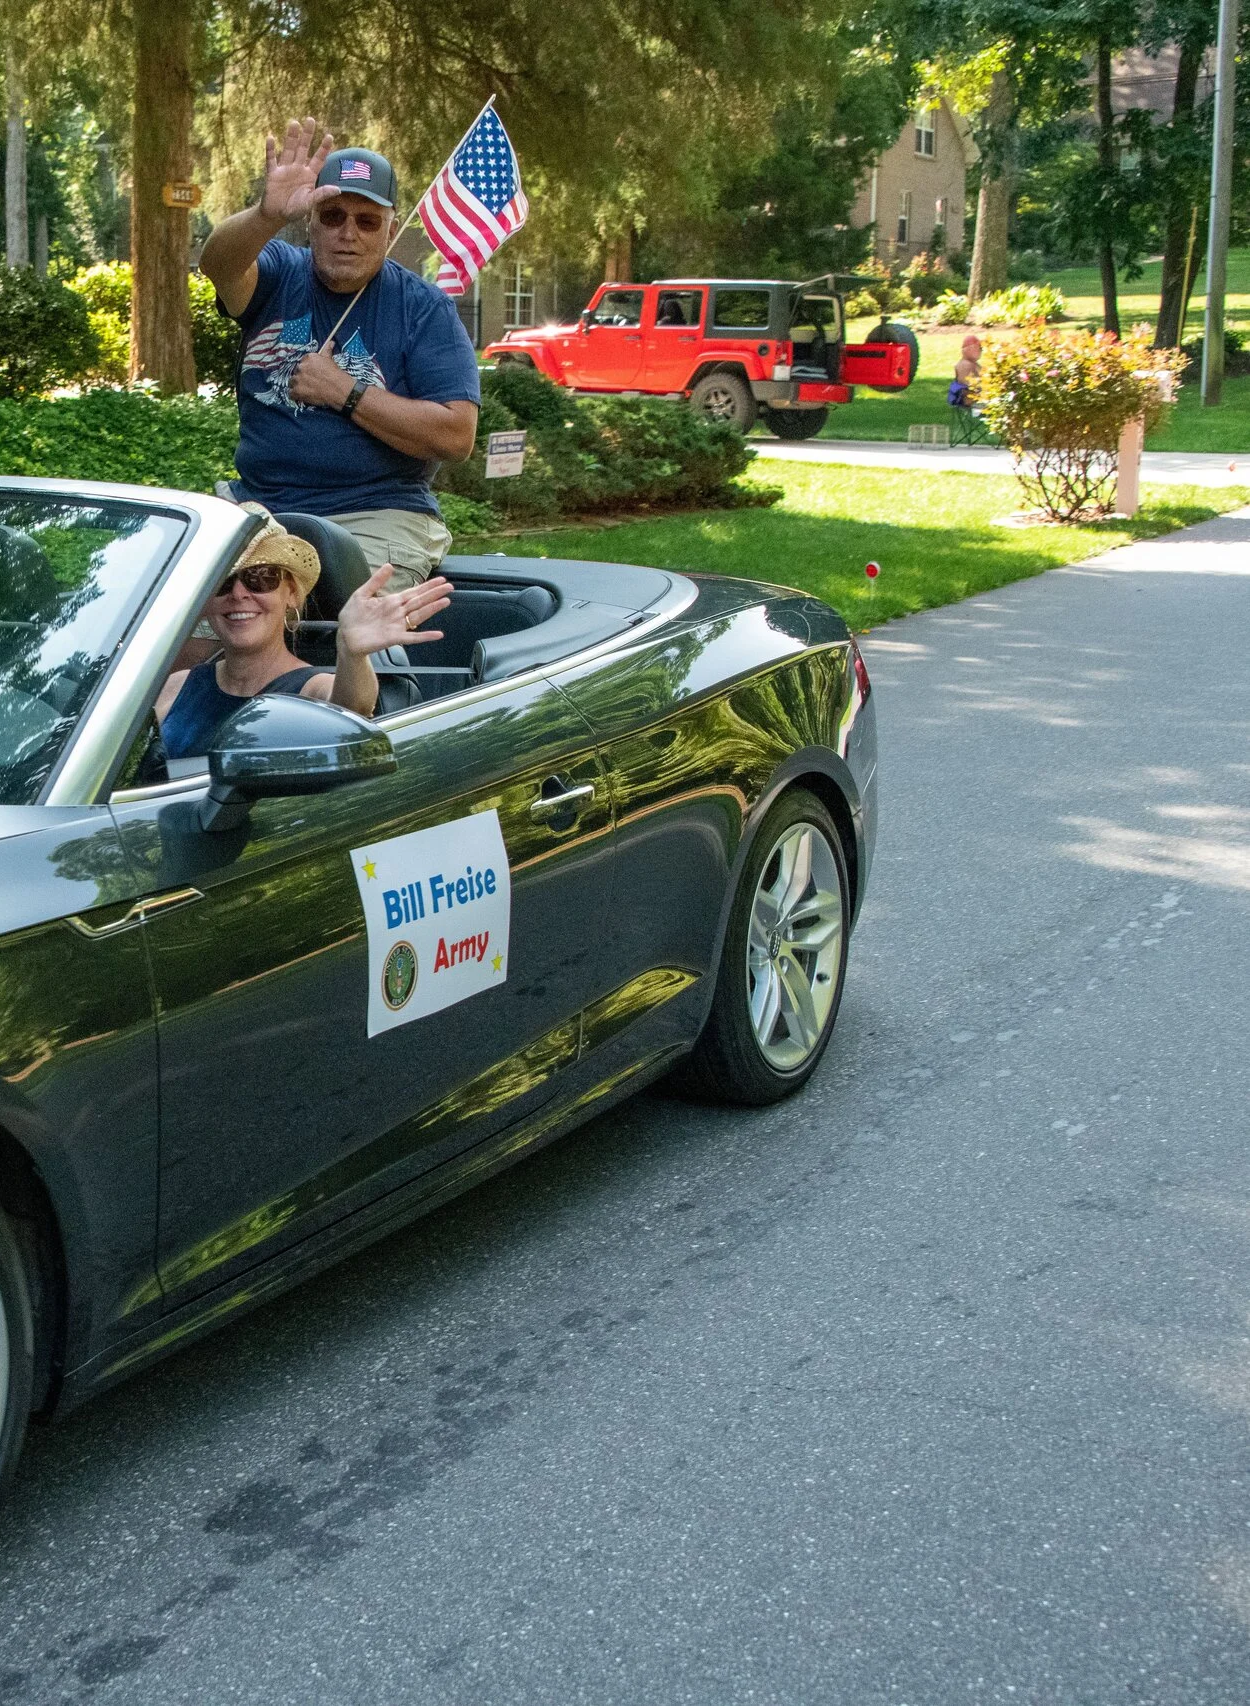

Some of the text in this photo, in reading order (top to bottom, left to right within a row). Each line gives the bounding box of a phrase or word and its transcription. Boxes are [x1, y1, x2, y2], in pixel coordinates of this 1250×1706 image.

[382, 866, 496, 929] Bill Freise
[434, 931, 490, 973] Army
